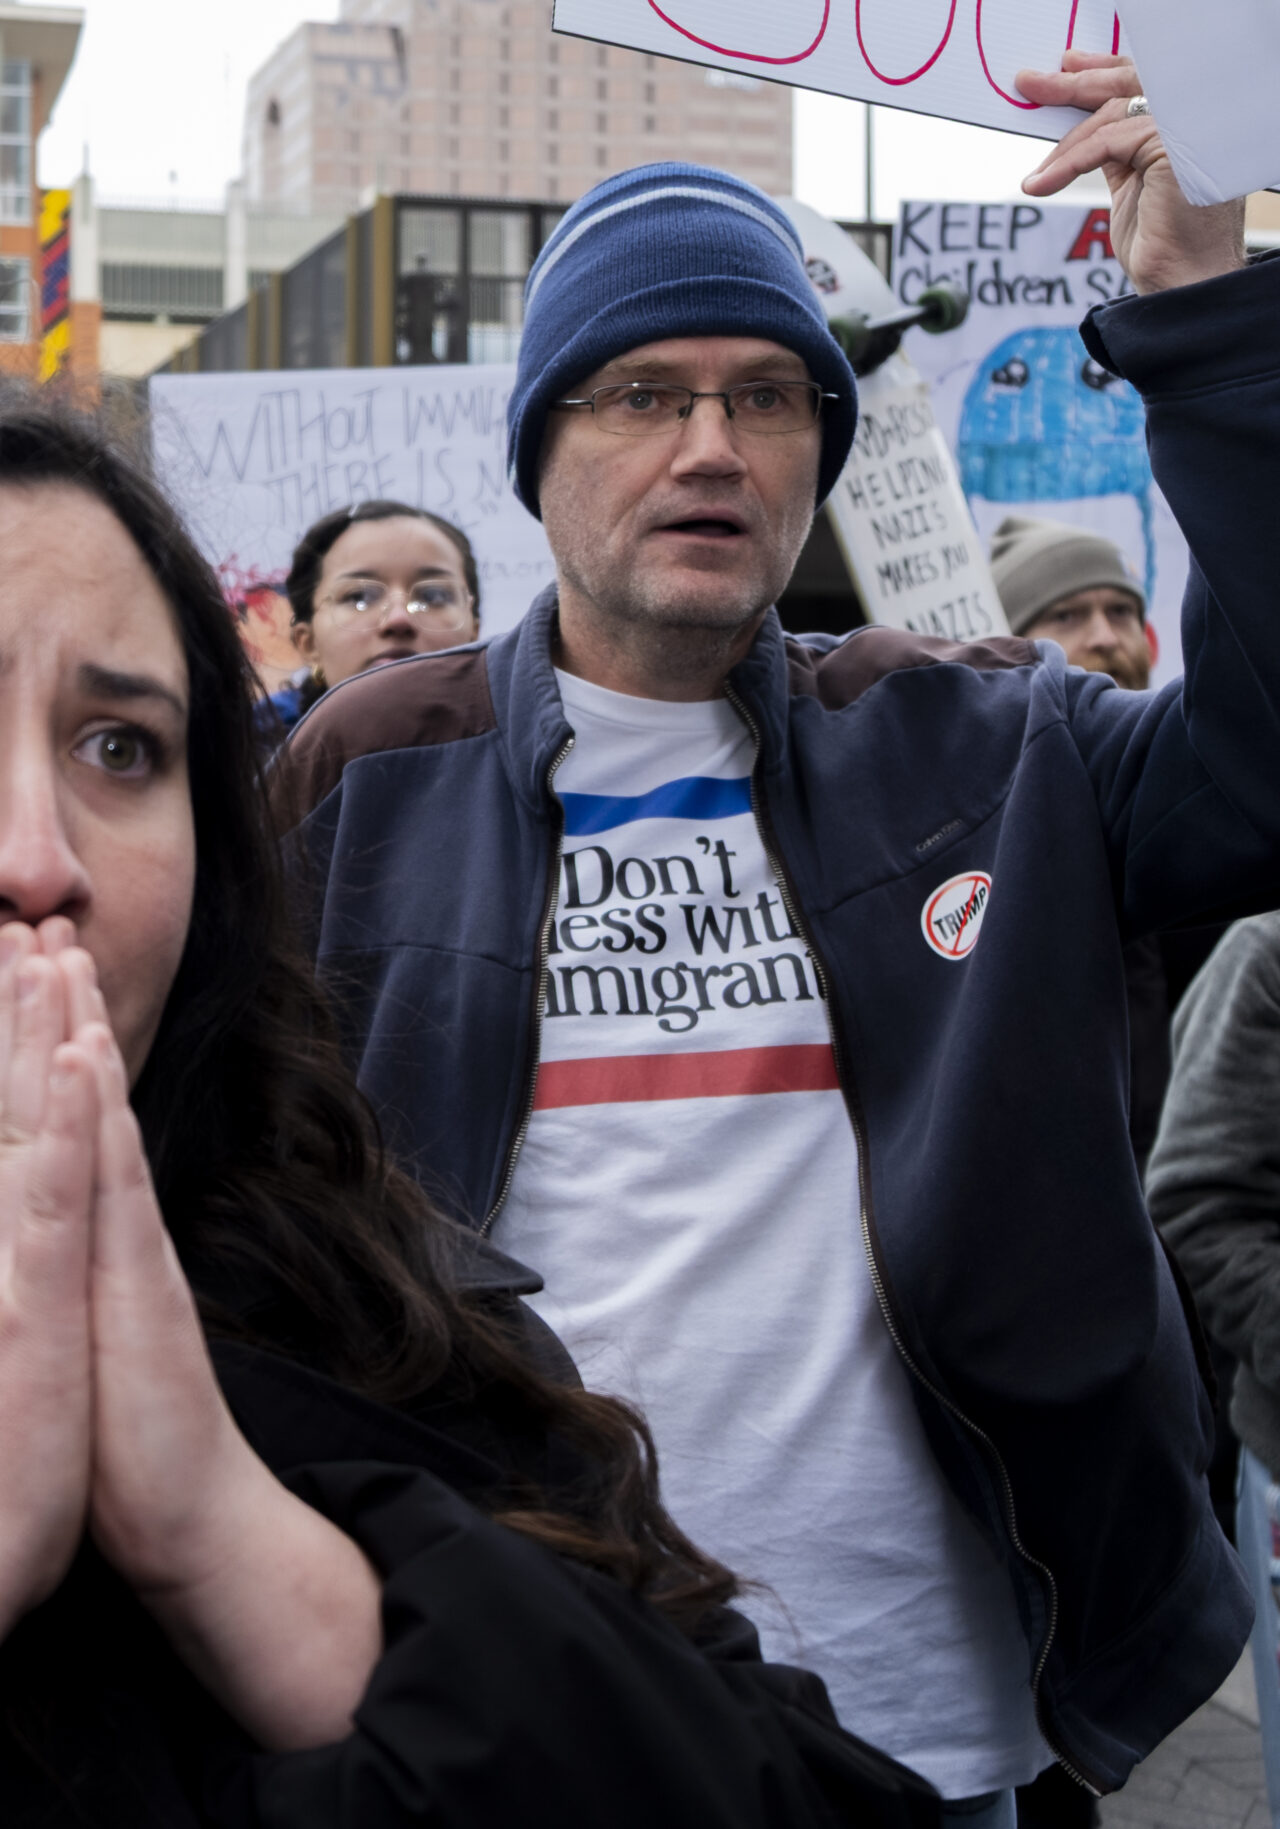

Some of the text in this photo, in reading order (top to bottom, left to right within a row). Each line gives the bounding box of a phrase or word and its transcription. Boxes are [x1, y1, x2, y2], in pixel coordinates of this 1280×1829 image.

[899, 202, 1043, 257] KEEP
[418, 447, 453, 508] IS
[871, 500, 948, 549] NAZIS
[915, 832, 944, 852] Calvin
[562, 836, 740, 909] Don't
[933, 886, 987, 941] TRUMP
[545, 950, 827, 1033] migran
